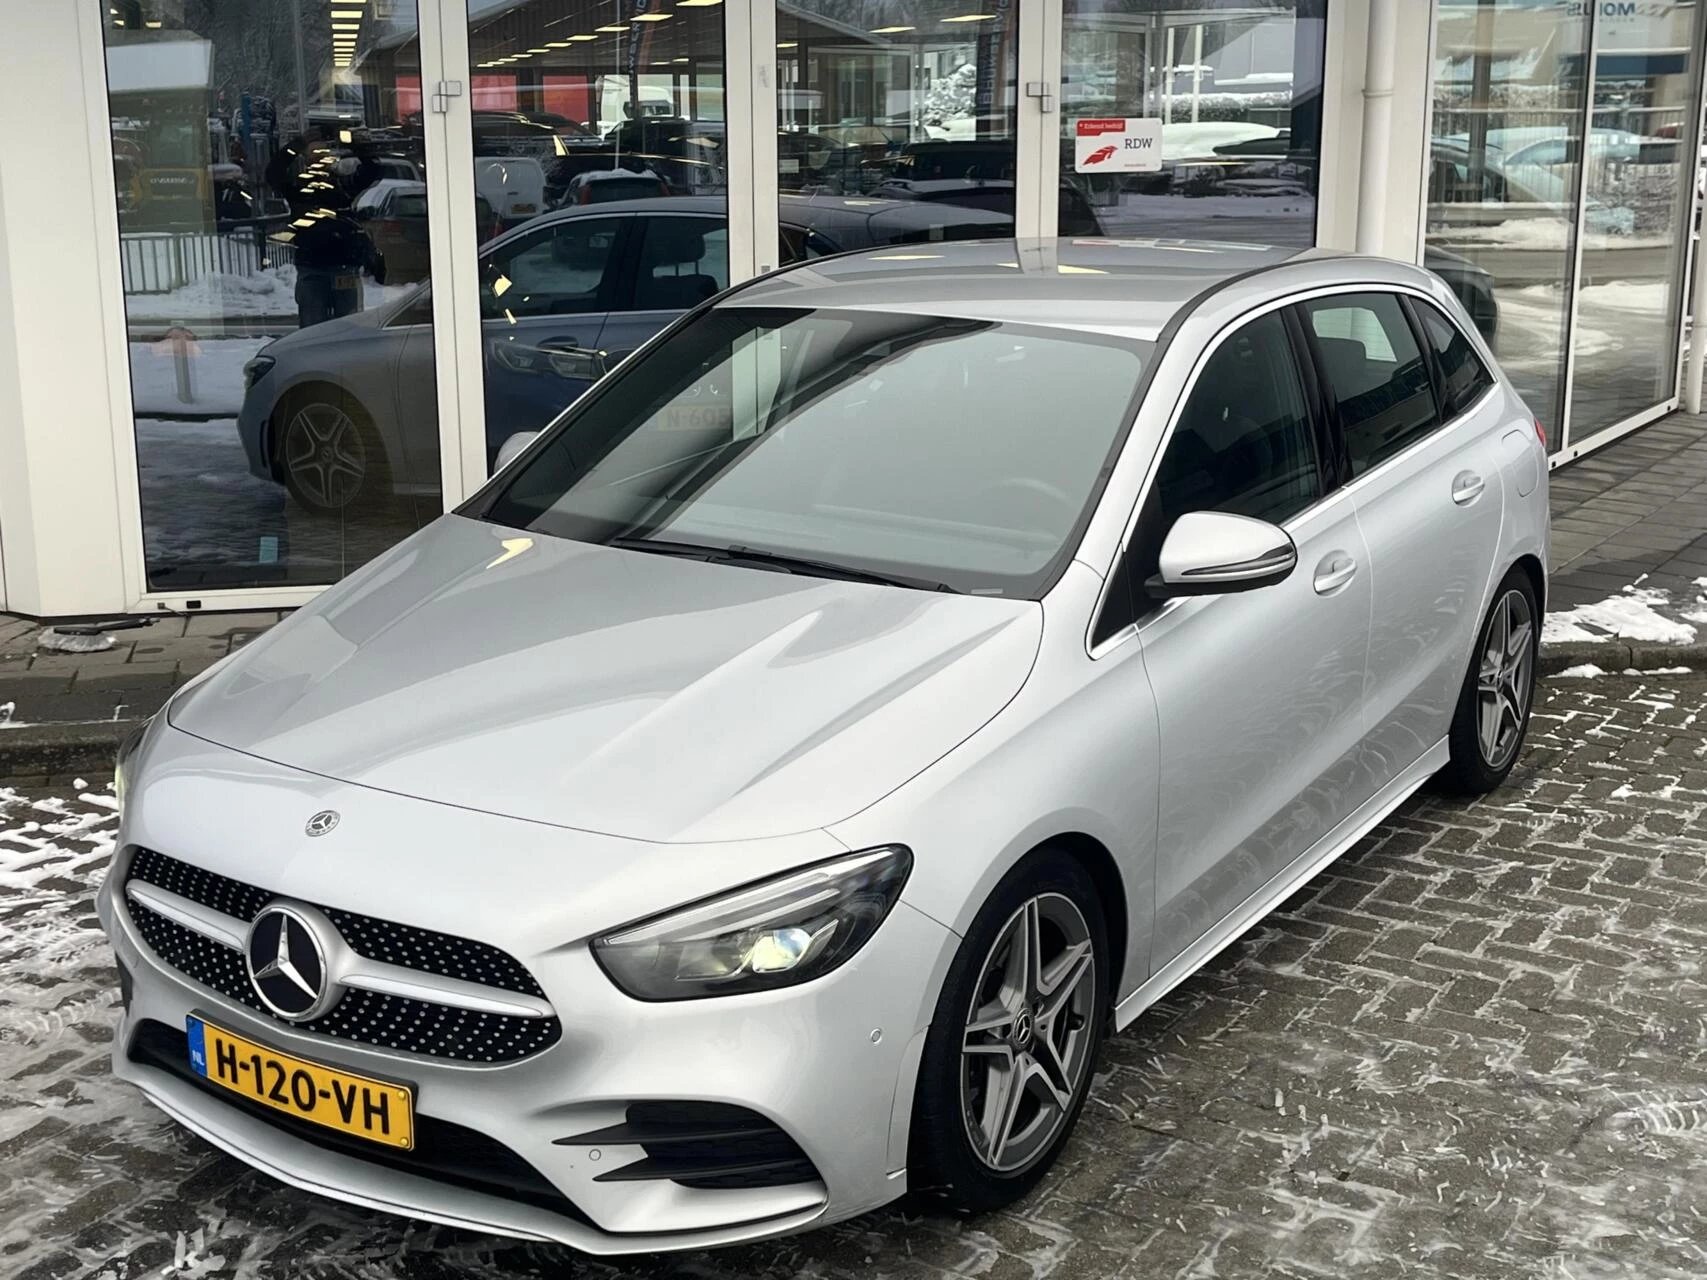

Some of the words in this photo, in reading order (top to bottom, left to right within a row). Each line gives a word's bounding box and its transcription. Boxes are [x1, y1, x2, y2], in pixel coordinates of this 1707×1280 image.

[1125, 138, 1153, 149] RDW
[192, 1050, 205, 1067] NL
[215, 1038, 390, 1135] H-120-VH
